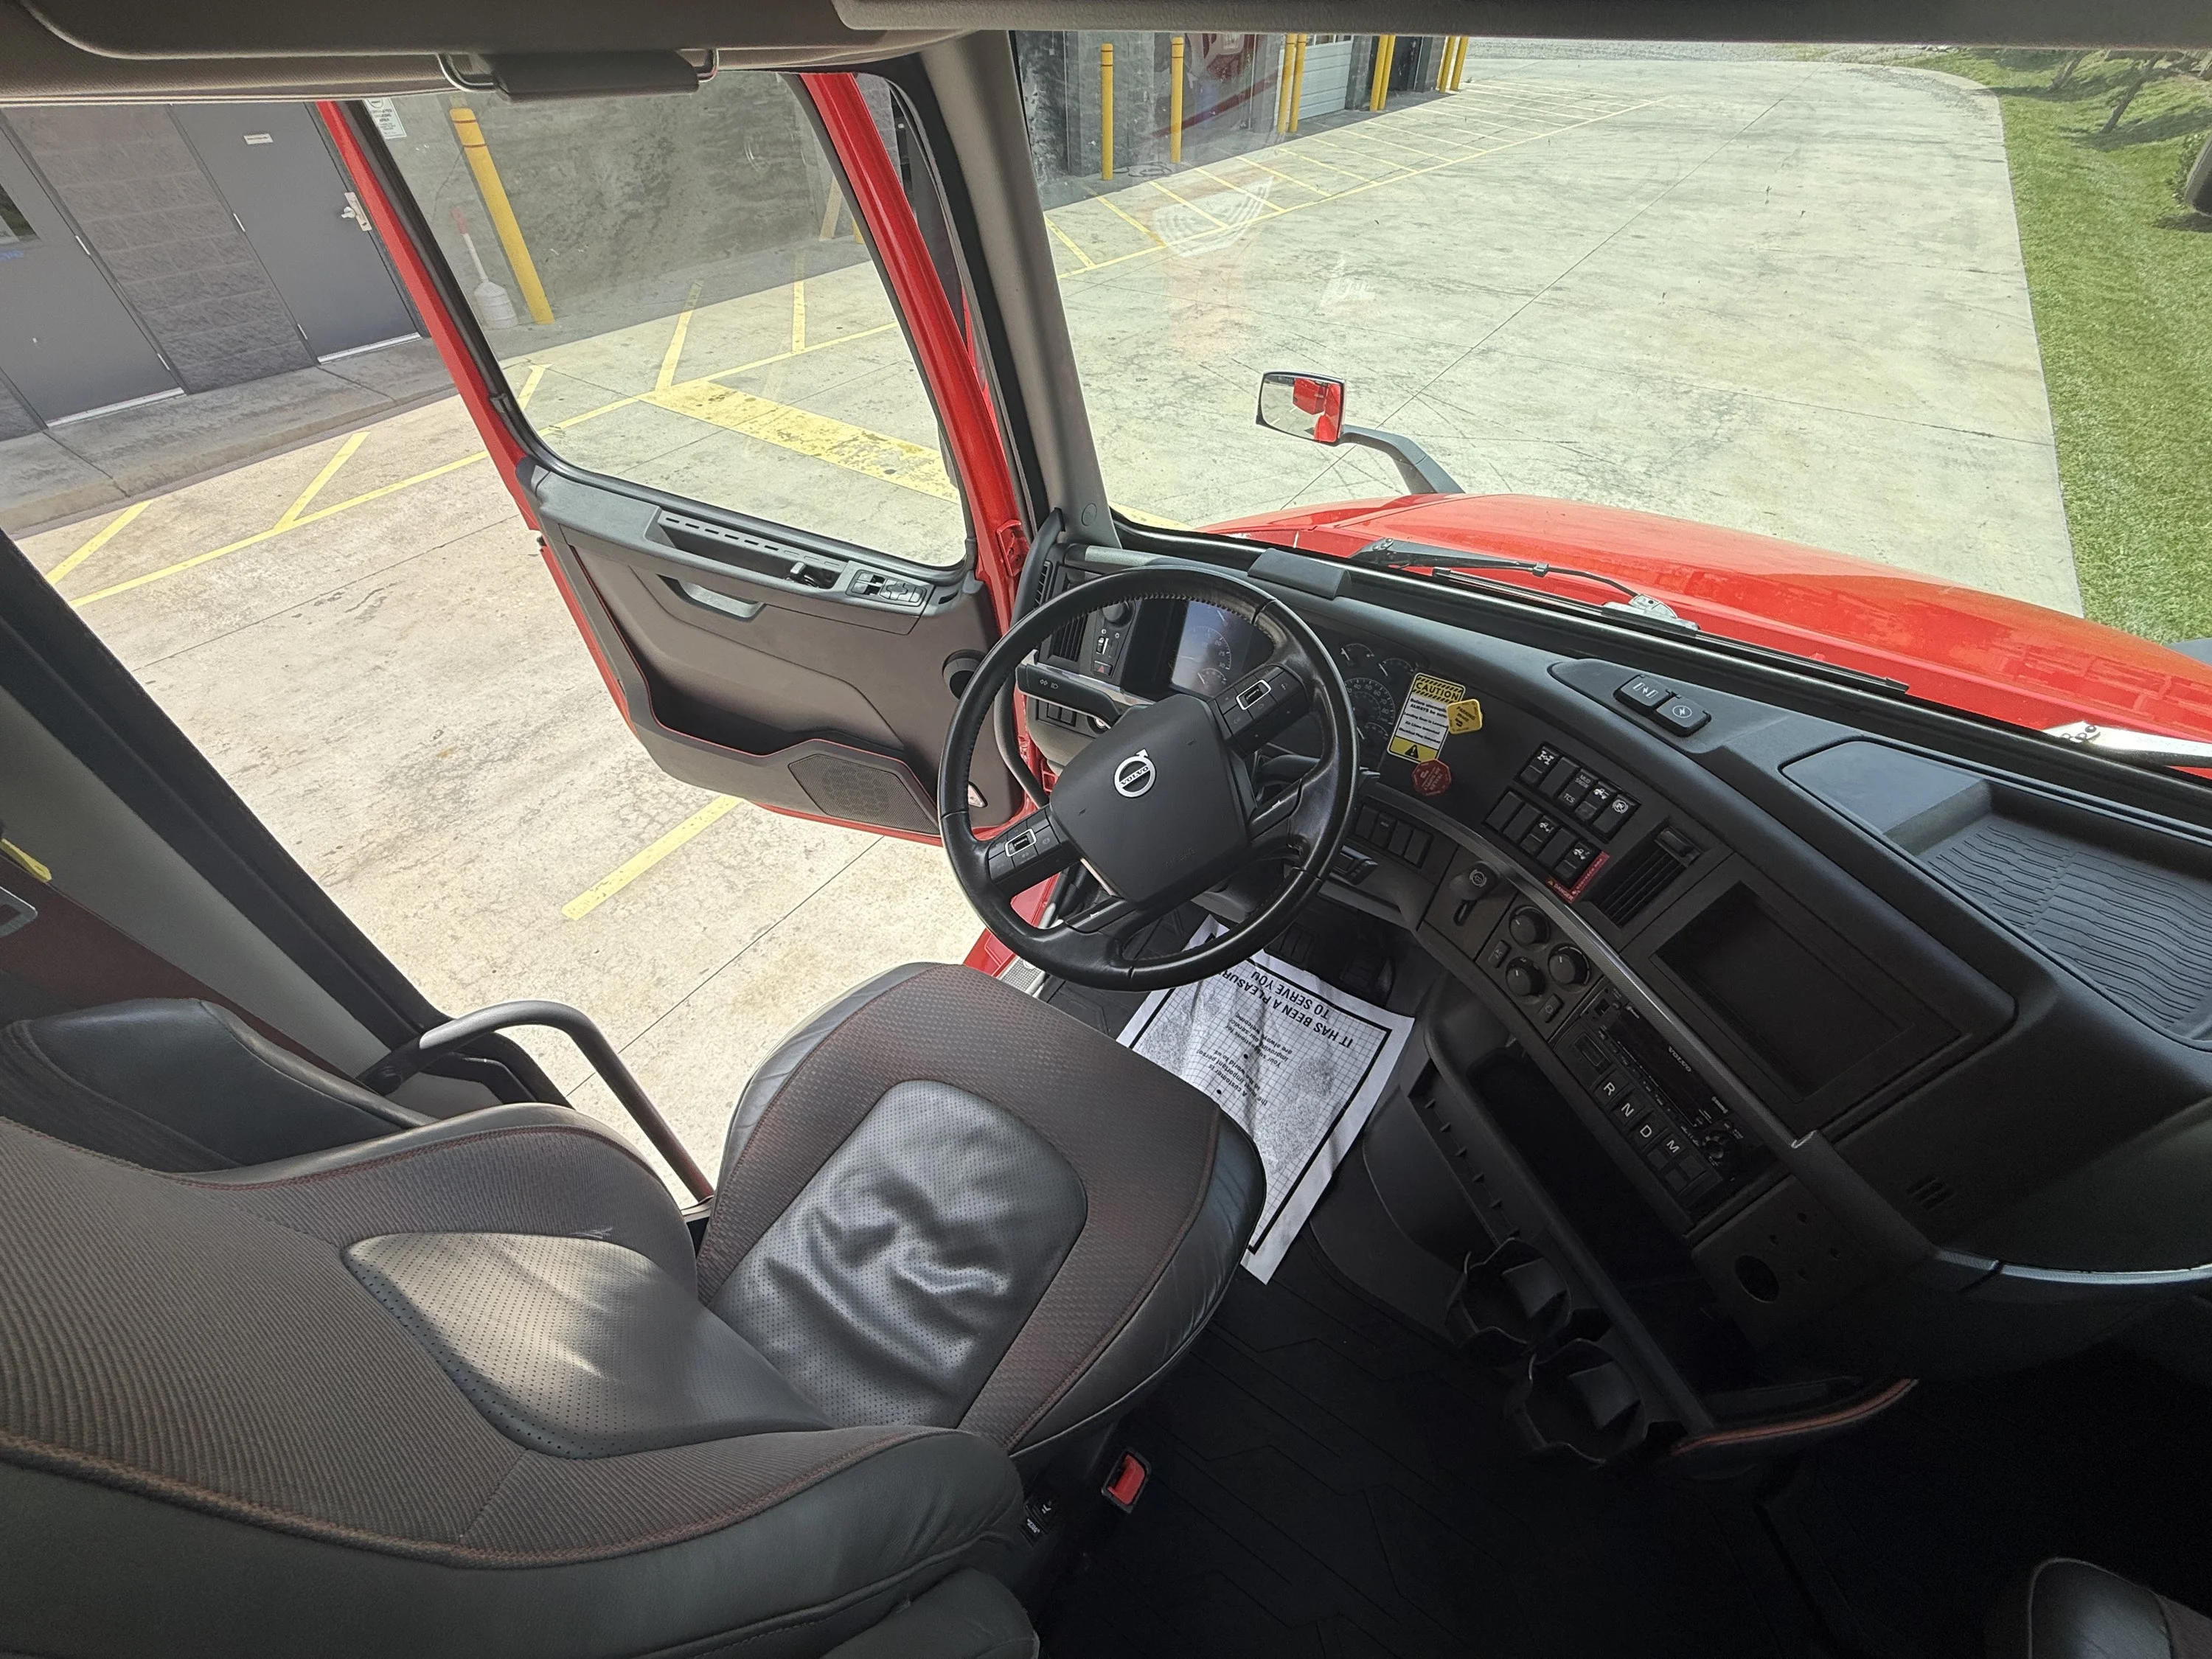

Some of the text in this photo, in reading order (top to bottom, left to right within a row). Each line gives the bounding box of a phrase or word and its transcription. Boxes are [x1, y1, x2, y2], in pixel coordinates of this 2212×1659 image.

[1416, 682, 1459, 700] CAUTION
[1410, 703, 1430, 713] ALWAYS
[1120, 766, 1149, 785] VOLVO
[1563, 793, 1576, 804] TCS
[1554, 883, 1574, 901] DANGER
[1251, 970, 1331, 1020] TO SERVE YOU
[1219, 969, 1354, 1048] IT HAS BEEN A PLEASUR
[1225, 1025, 1234, 1033] for
[1248, 1033, 1259, 1042] our
[1281, 1046, 1293, 1055] are
[1222, 1054, 1230, 1062] to
[1267, 1057, 1281, 1068] Your
[1668, 1046, 1691, 1072] VOLVO
[1228, 1060, 1245, 1075] world
[1197, 1049, 1268, 1106] the most important perso
[1214, 1069, 1242, 1093] customer
[1603, 1082, 1615, 1096] R
[1621, 1102, 1635, 1117] N
[1639, 1124, 1652, 1138] D
[1666, 1139, 1680, 1153] M
